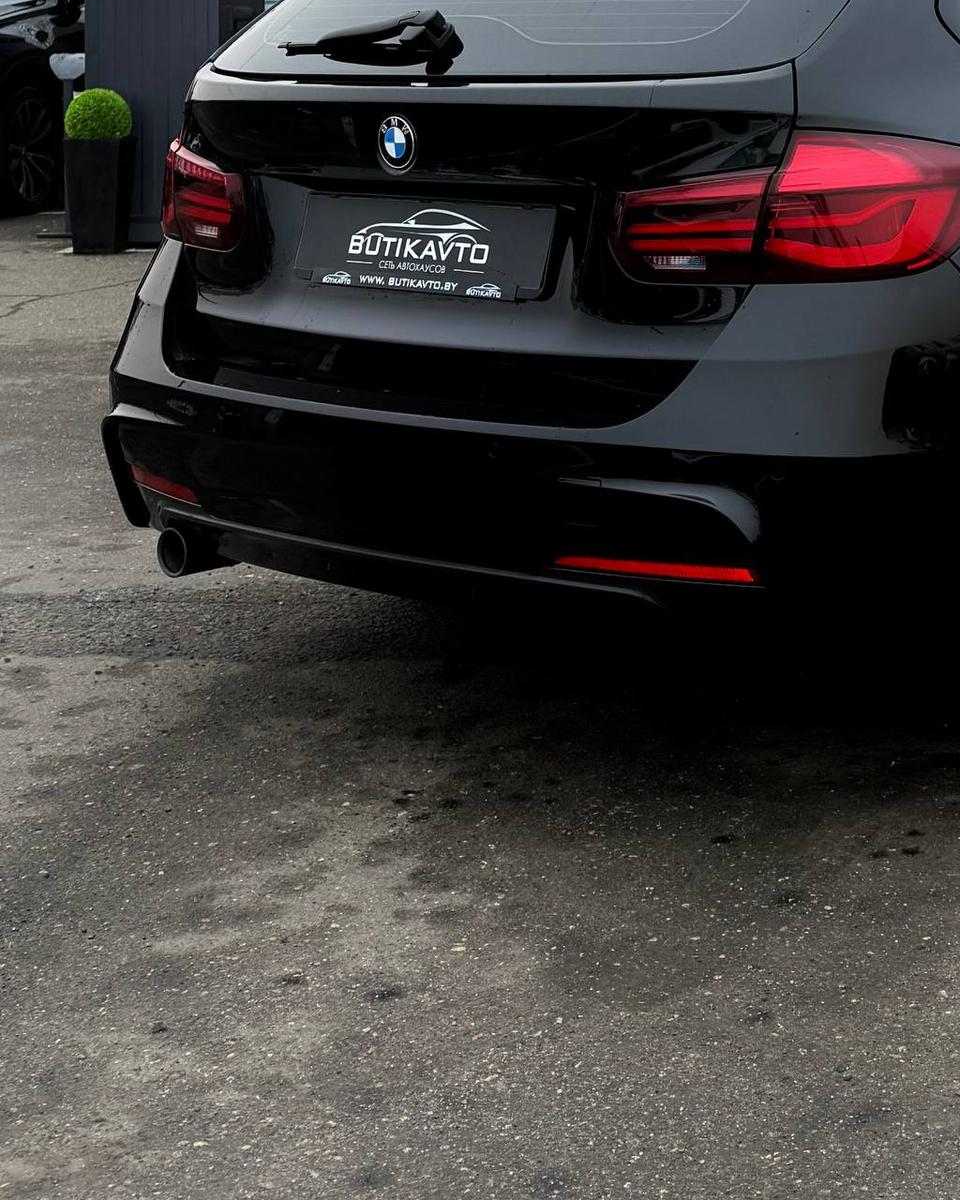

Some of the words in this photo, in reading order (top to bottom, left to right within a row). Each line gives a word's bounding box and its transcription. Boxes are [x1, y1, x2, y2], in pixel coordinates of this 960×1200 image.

[348, 234, 489, 264] BUTIKAVTO
[379, 260, 395, 269] СЕТЬ
[396, 262, 446, 273] АВТОХАУСОВ
[359, 274, 385, 285] WWW.
[388, 277, 458, 291] BUTIKAVTO.BY
